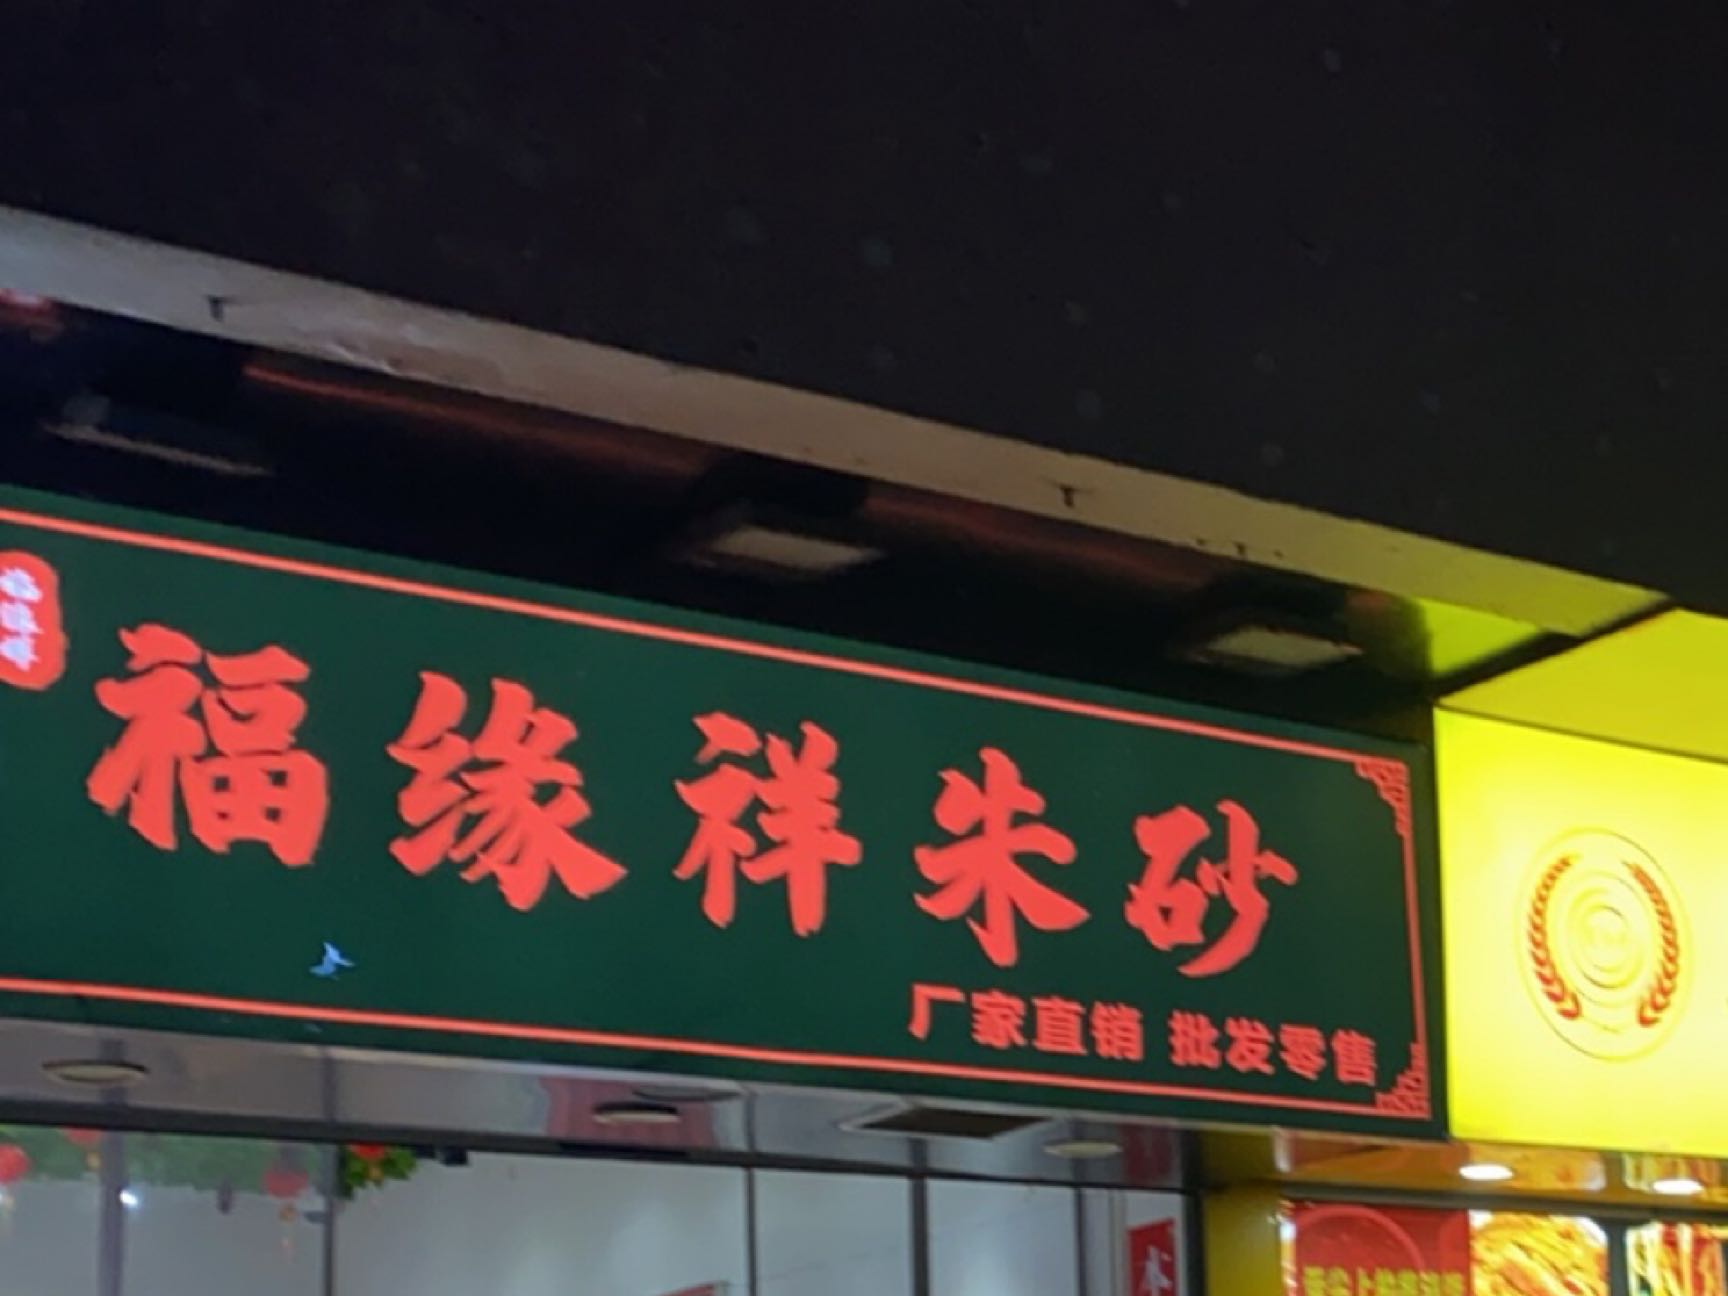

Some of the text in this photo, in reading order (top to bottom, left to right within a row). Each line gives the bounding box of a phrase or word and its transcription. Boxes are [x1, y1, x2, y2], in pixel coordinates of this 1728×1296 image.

[87, 622, 1297, 977] 福缘祥朱砂
[908, 983, 1379, 1087] 厂家直销 批发零售
